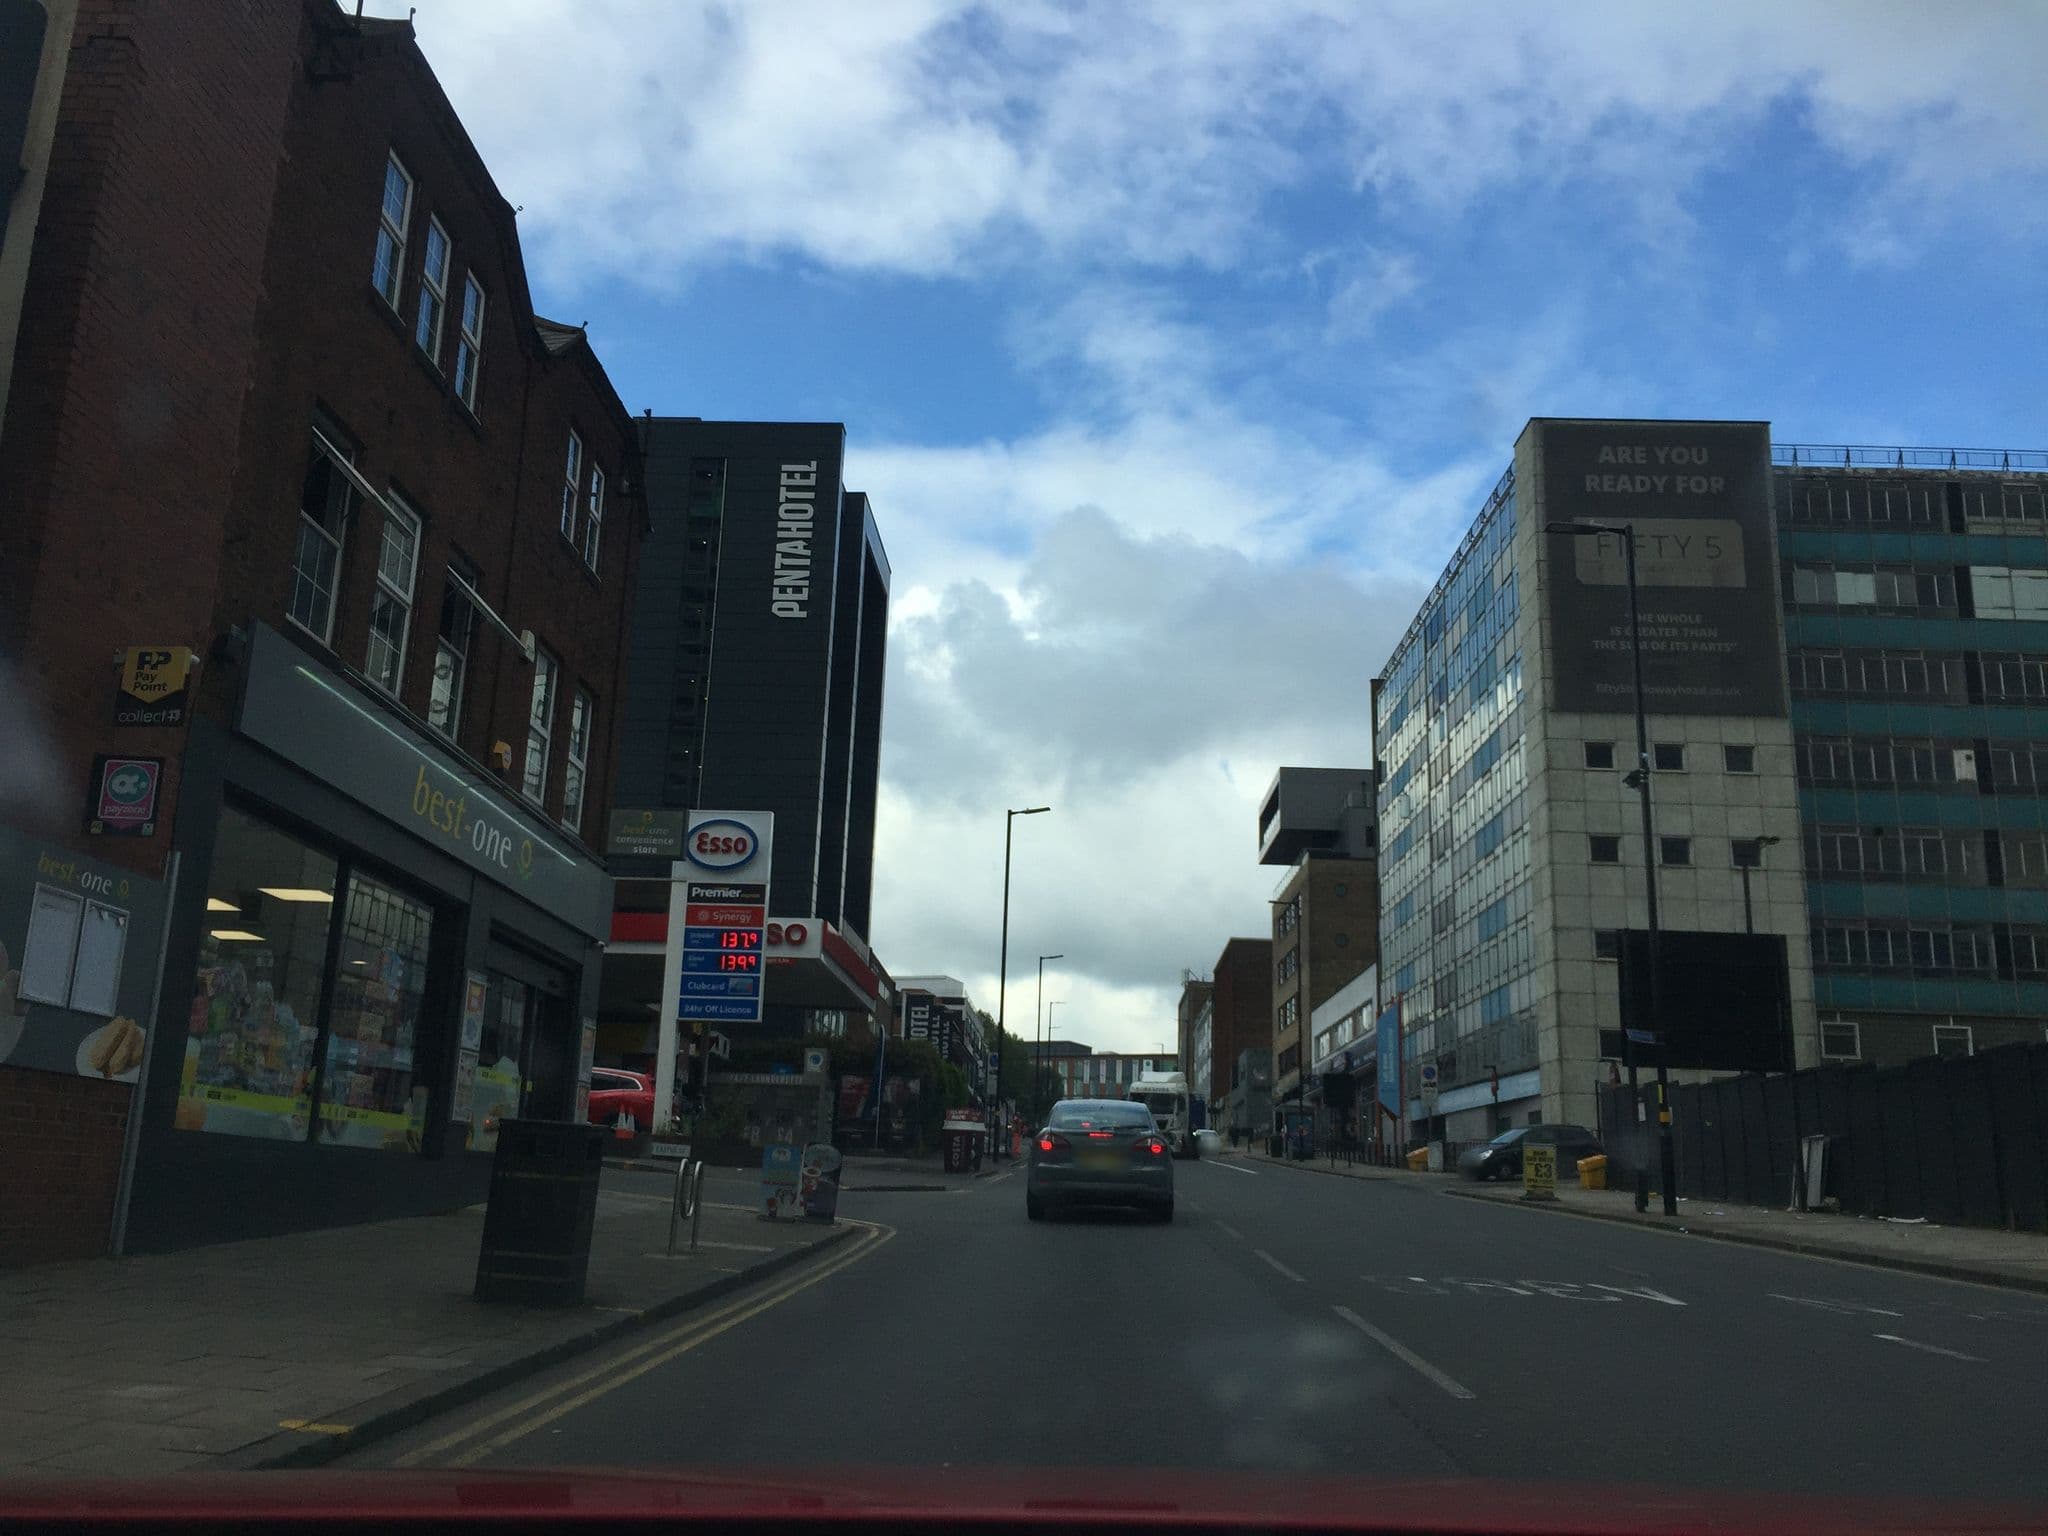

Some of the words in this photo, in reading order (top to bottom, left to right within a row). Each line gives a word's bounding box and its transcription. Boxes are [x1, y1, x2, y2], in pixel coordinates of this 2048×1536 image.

[1598, 445, 1646, 464] ARE
[1654, 446, 1708, 464] YOU
[1584, 475, 1670, 494] READY
[1677, 475, 1725, 495] FOR
[771, 460, 817, 618] PENTAHOTEL
[1706, 535, 1722, 560] 5
[1657, 614, 1703, 624] WHOLE
[1610, 627, 1622, 636] IS
[1684, 628, 1718, 638] THAN
[1593, 640, 1617, 649] THE
[1652, 641, 1667, 651] OF
[1670, 641, 1689, 652] ITS
[135, 672, 157, 683] Pay
[133, 682, 168, 692] Point
[412, 766, 512, 869] best-one
[616, 836, 674, 847] convenience
[633, 845, 658, 855] store
[691, 886, 742, 898] Premier
[712, 910, 753, 925] Synergy
[687, 979, 725, 991] Clubcard
[705, 1002, 719, 1014] Off
[720, 1004, 752, 1014] Licence
